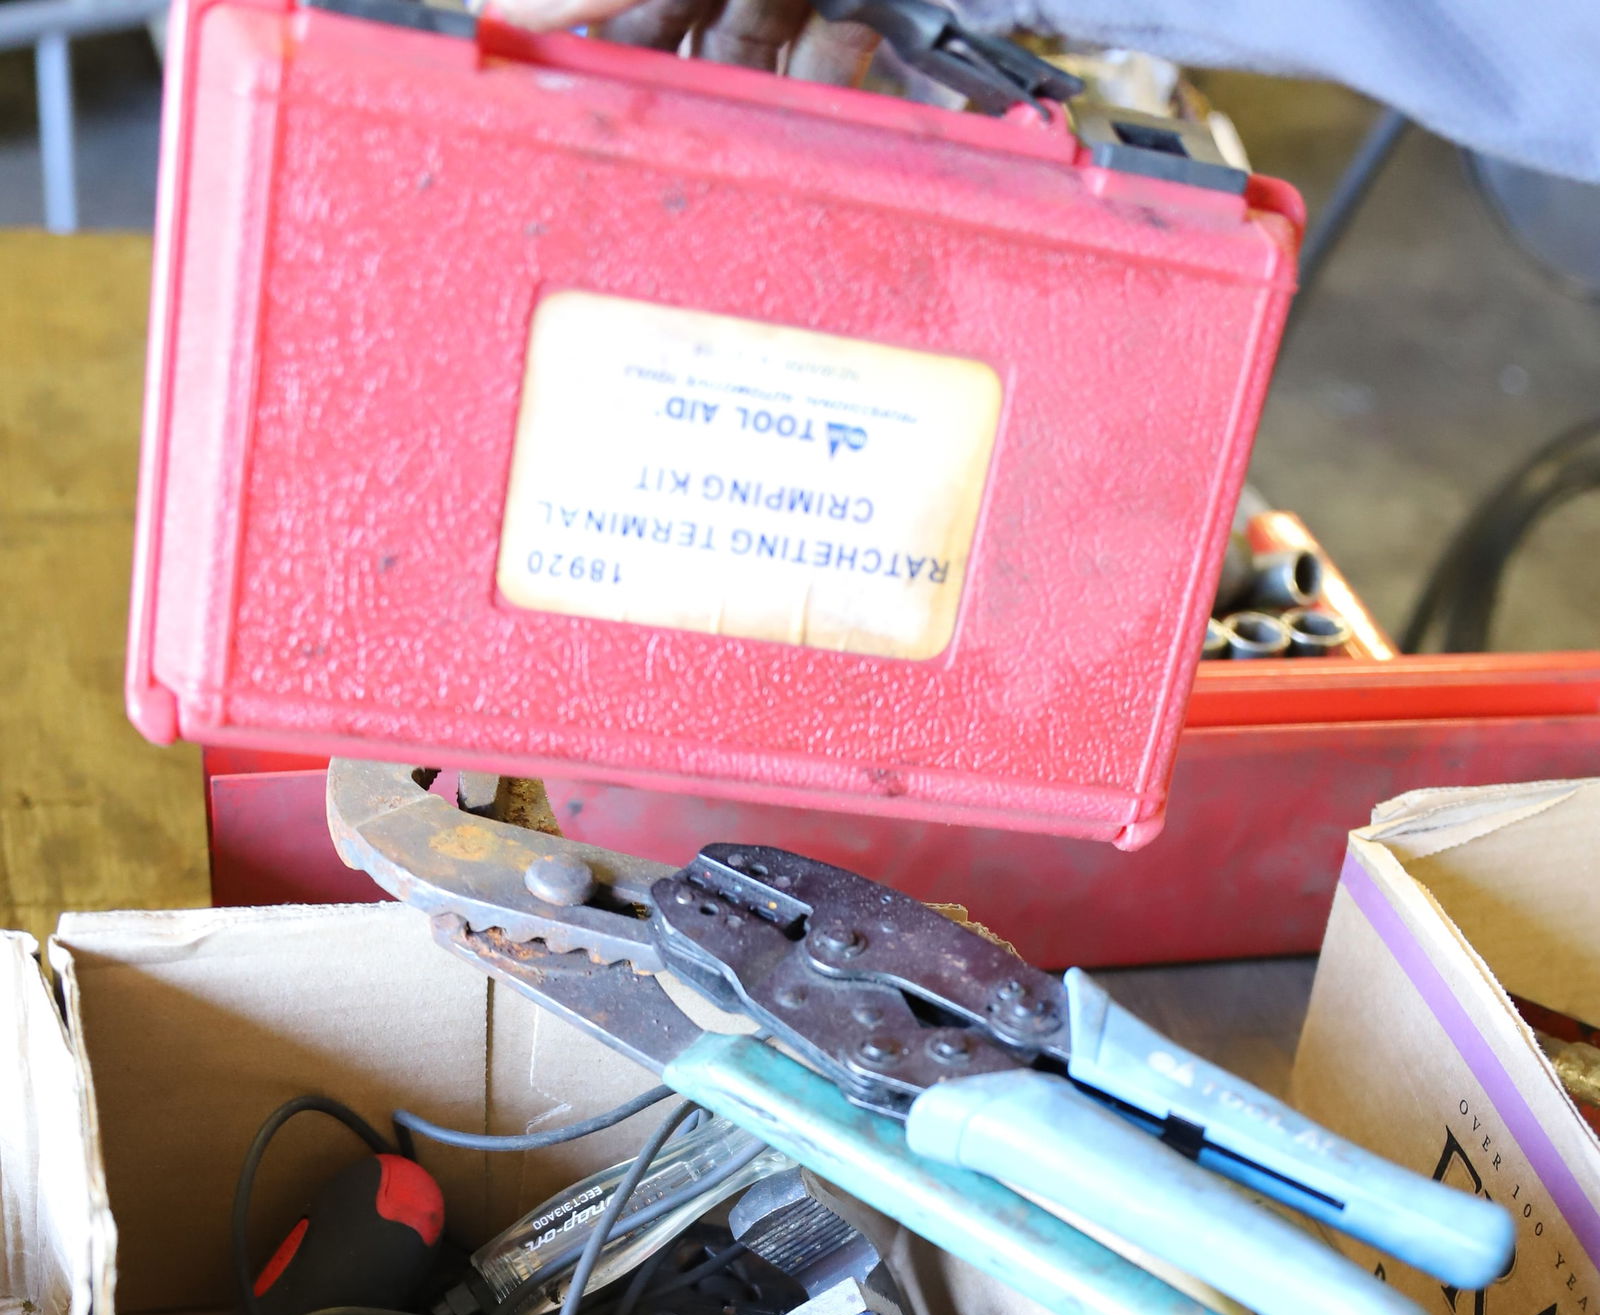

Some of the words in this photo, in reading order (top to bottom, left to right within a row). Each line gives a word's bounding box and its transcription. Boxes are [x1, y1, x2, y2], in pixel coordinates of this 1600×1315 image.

[664, 396, 721, 424] AID
[735, 405, 816, 443] TOOL
[635, 466, 691, 495] KIT
[701, 473, 876, 526] CRIMPING
[539, 500, 717, 552] TERMINAL
[526, 549, 623, 585] 18920
[731, 529, 951, 585] RATCHETING
[1459, 1099, 1502, 1172] OVER
[1512, 1184, 1543, 1237] 100
